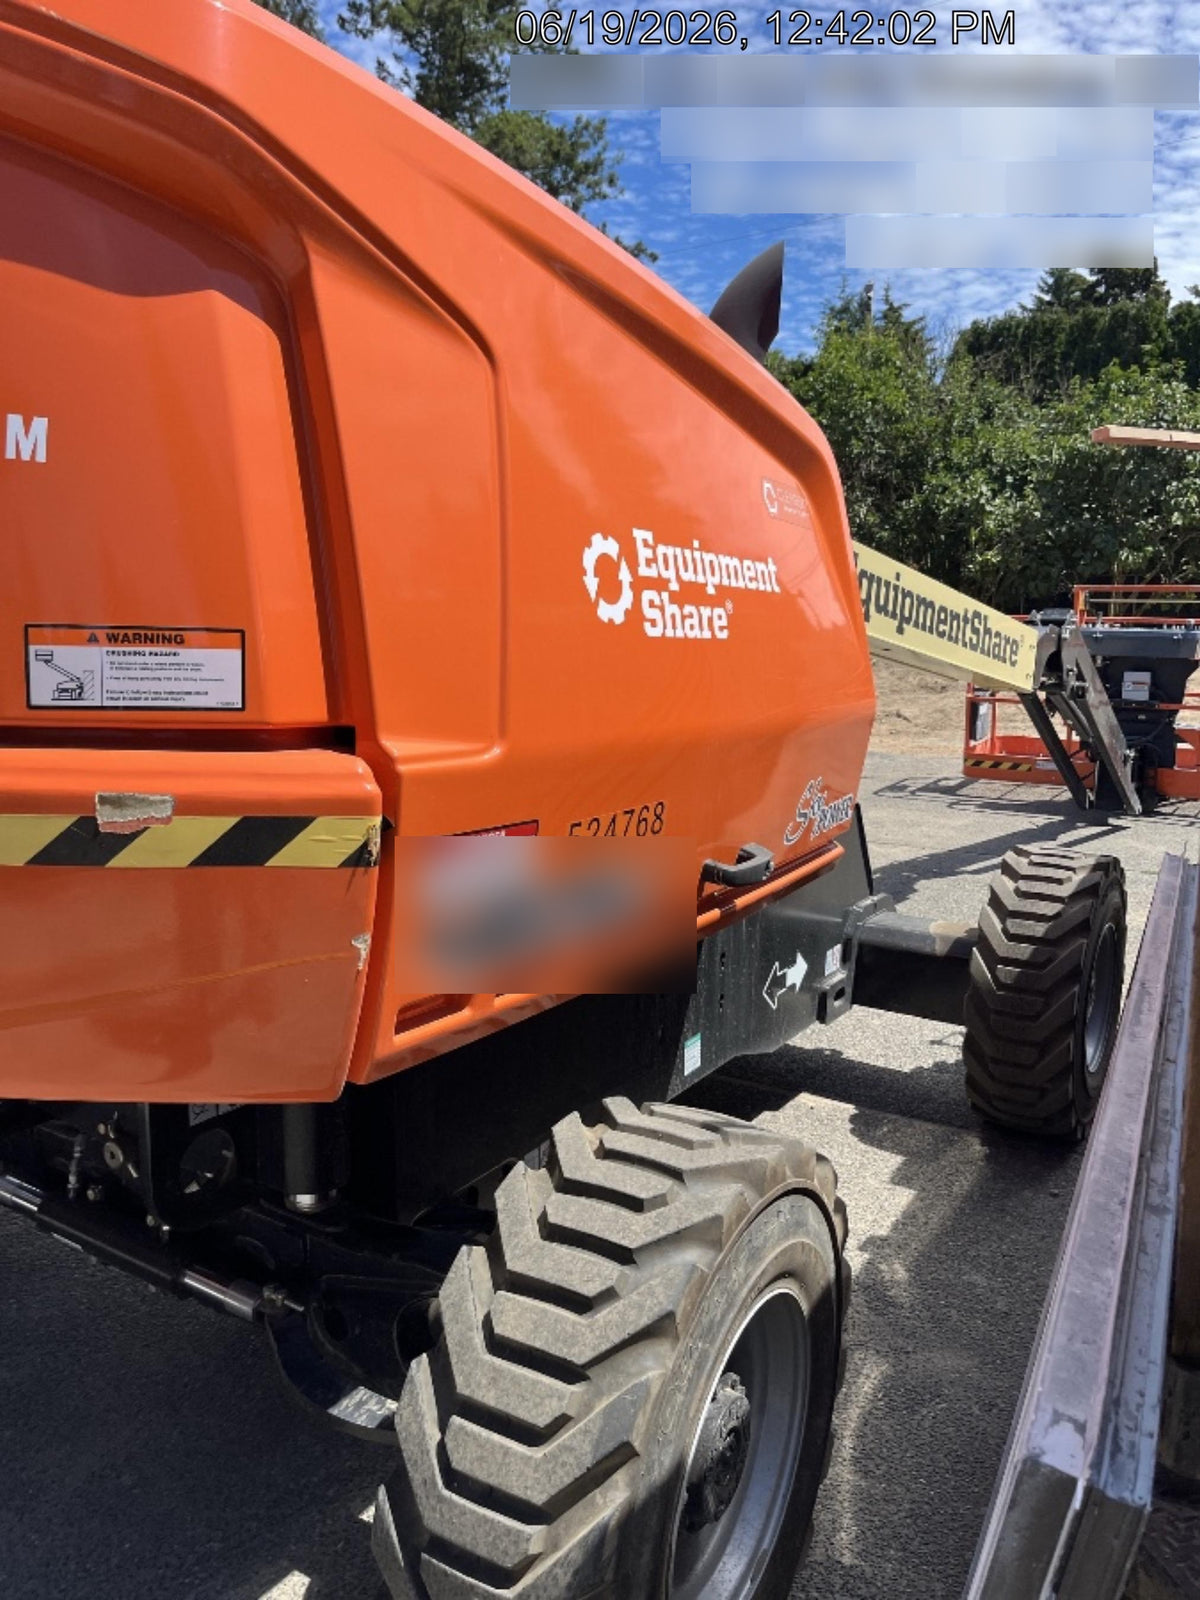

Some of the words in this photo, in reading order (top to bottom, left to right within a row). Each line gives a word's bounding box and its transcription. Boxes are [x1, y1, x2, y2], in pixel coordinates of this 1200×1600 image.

[4, 412, 49, 463] M
[631, 527, 781, 596] Equipment
[106, 632, 185, 645] WARNING
[853, 551, 1020, 668] quipmentShare
